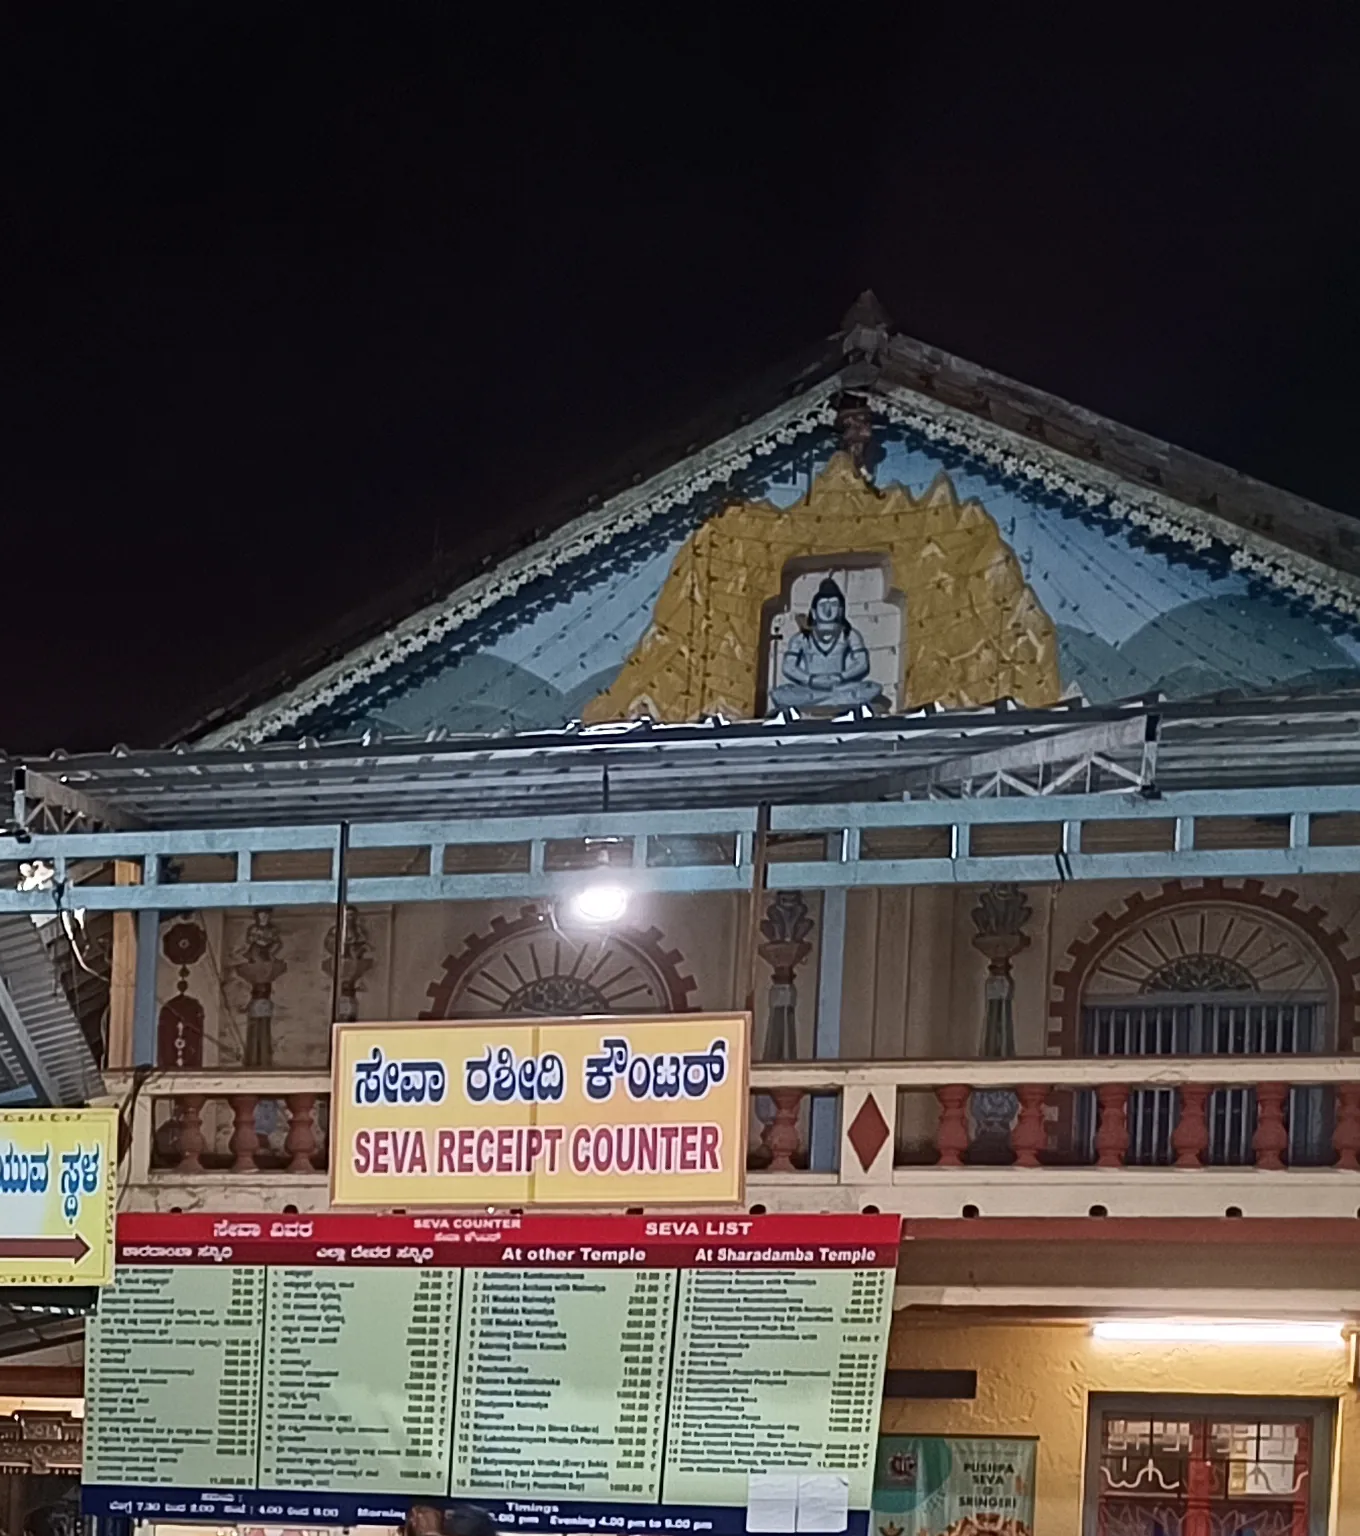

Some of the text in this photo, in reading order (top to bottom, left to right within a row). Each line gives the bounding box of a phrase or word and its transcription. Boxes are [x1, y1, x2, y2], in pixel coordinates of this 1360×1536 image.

[355, 1038, 727, 1103] ಸೇವಾ ರಶೀದಿ ಕೌಂಟರ್
[354, 1126, 720, 1174] SEVA RECEIPT COUNTER
[61, 1142, 100, 1224] ಸ್ಥಳ
[413, 1219, 521, 1229] SEVA COUNTER
[645, 1221, 753, 1236] SEVA LIST
[502, 1247, 646, 1264] At other Temple
[695, 1247, 877, 1264] At Sharadamba Temple
[972, 1474, 1005, 1485] SEVA
[506, 1502, 559, 1514] Timings
[549, 1514, 596, 1528] Evening
